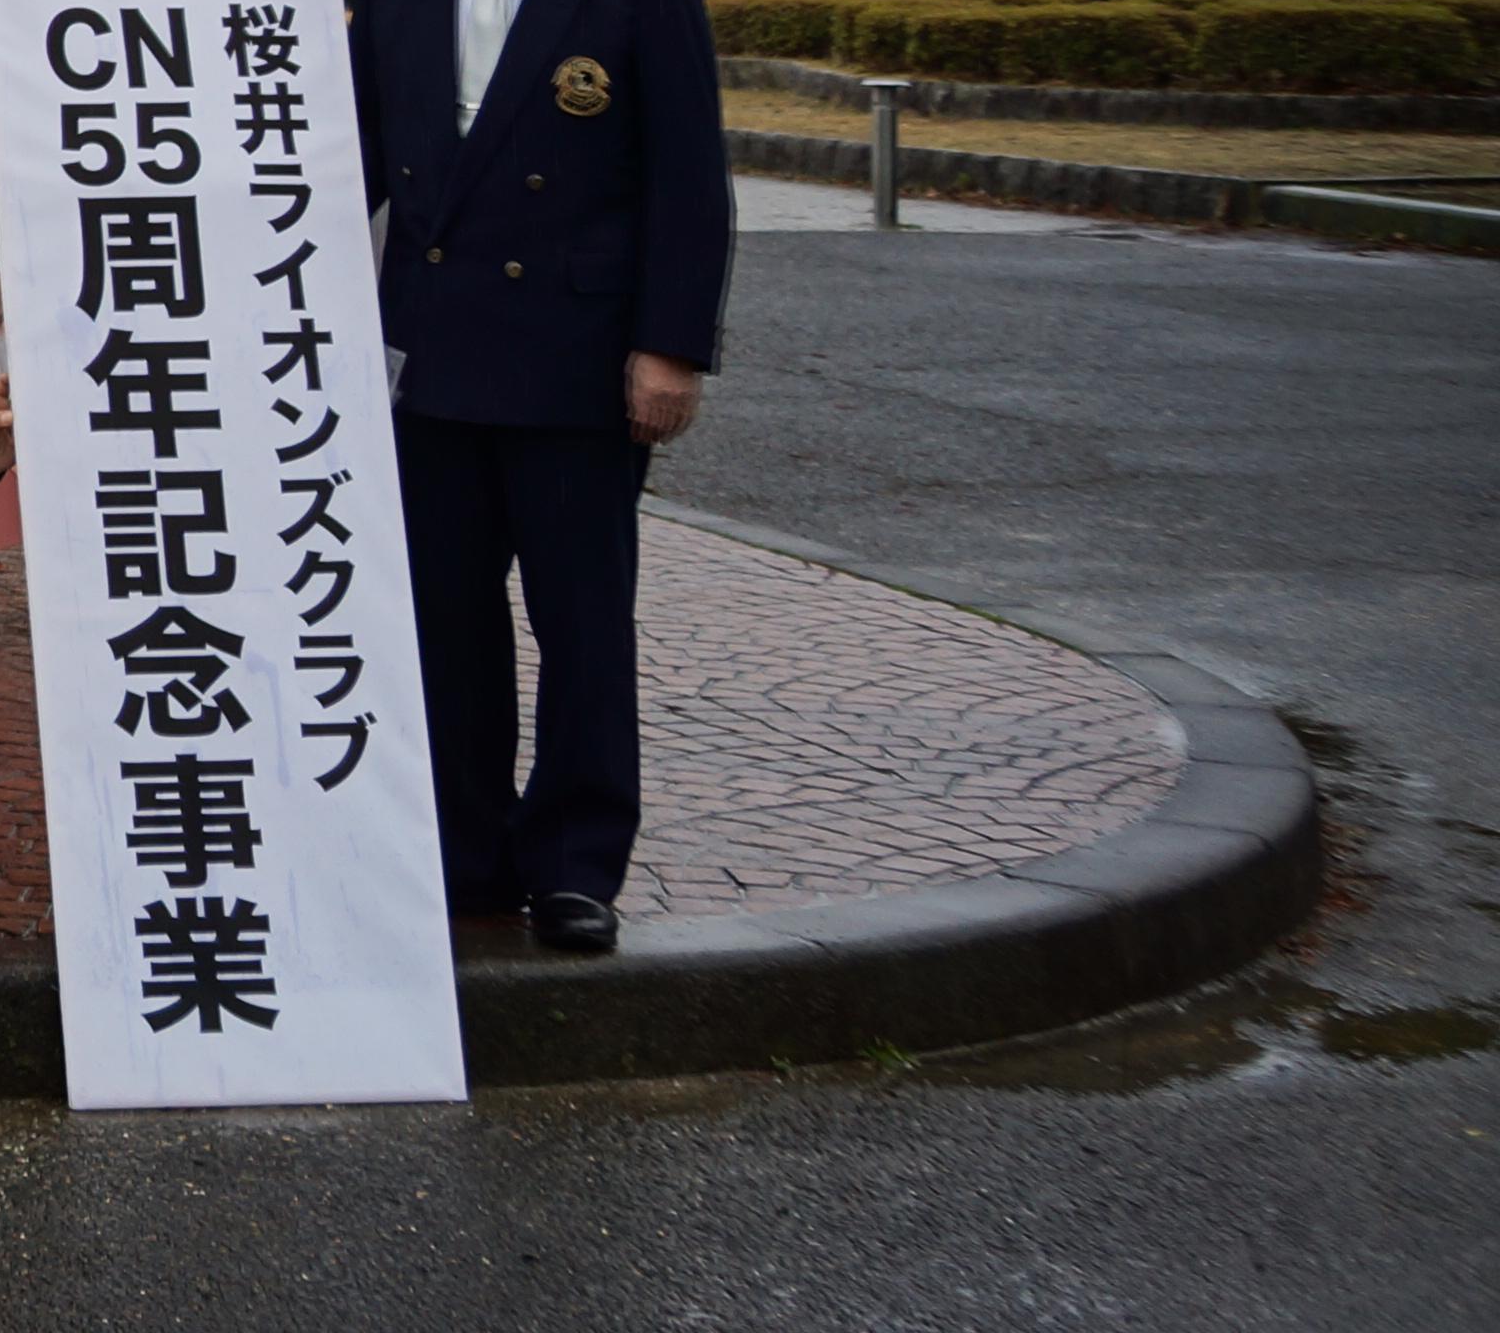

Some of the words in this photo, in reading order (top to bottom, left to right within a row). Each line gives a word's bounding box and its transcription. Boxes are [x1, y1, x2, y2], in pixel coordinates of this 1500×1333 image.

[222, 1, 379, 792] 桜井ライオンズクラブ
